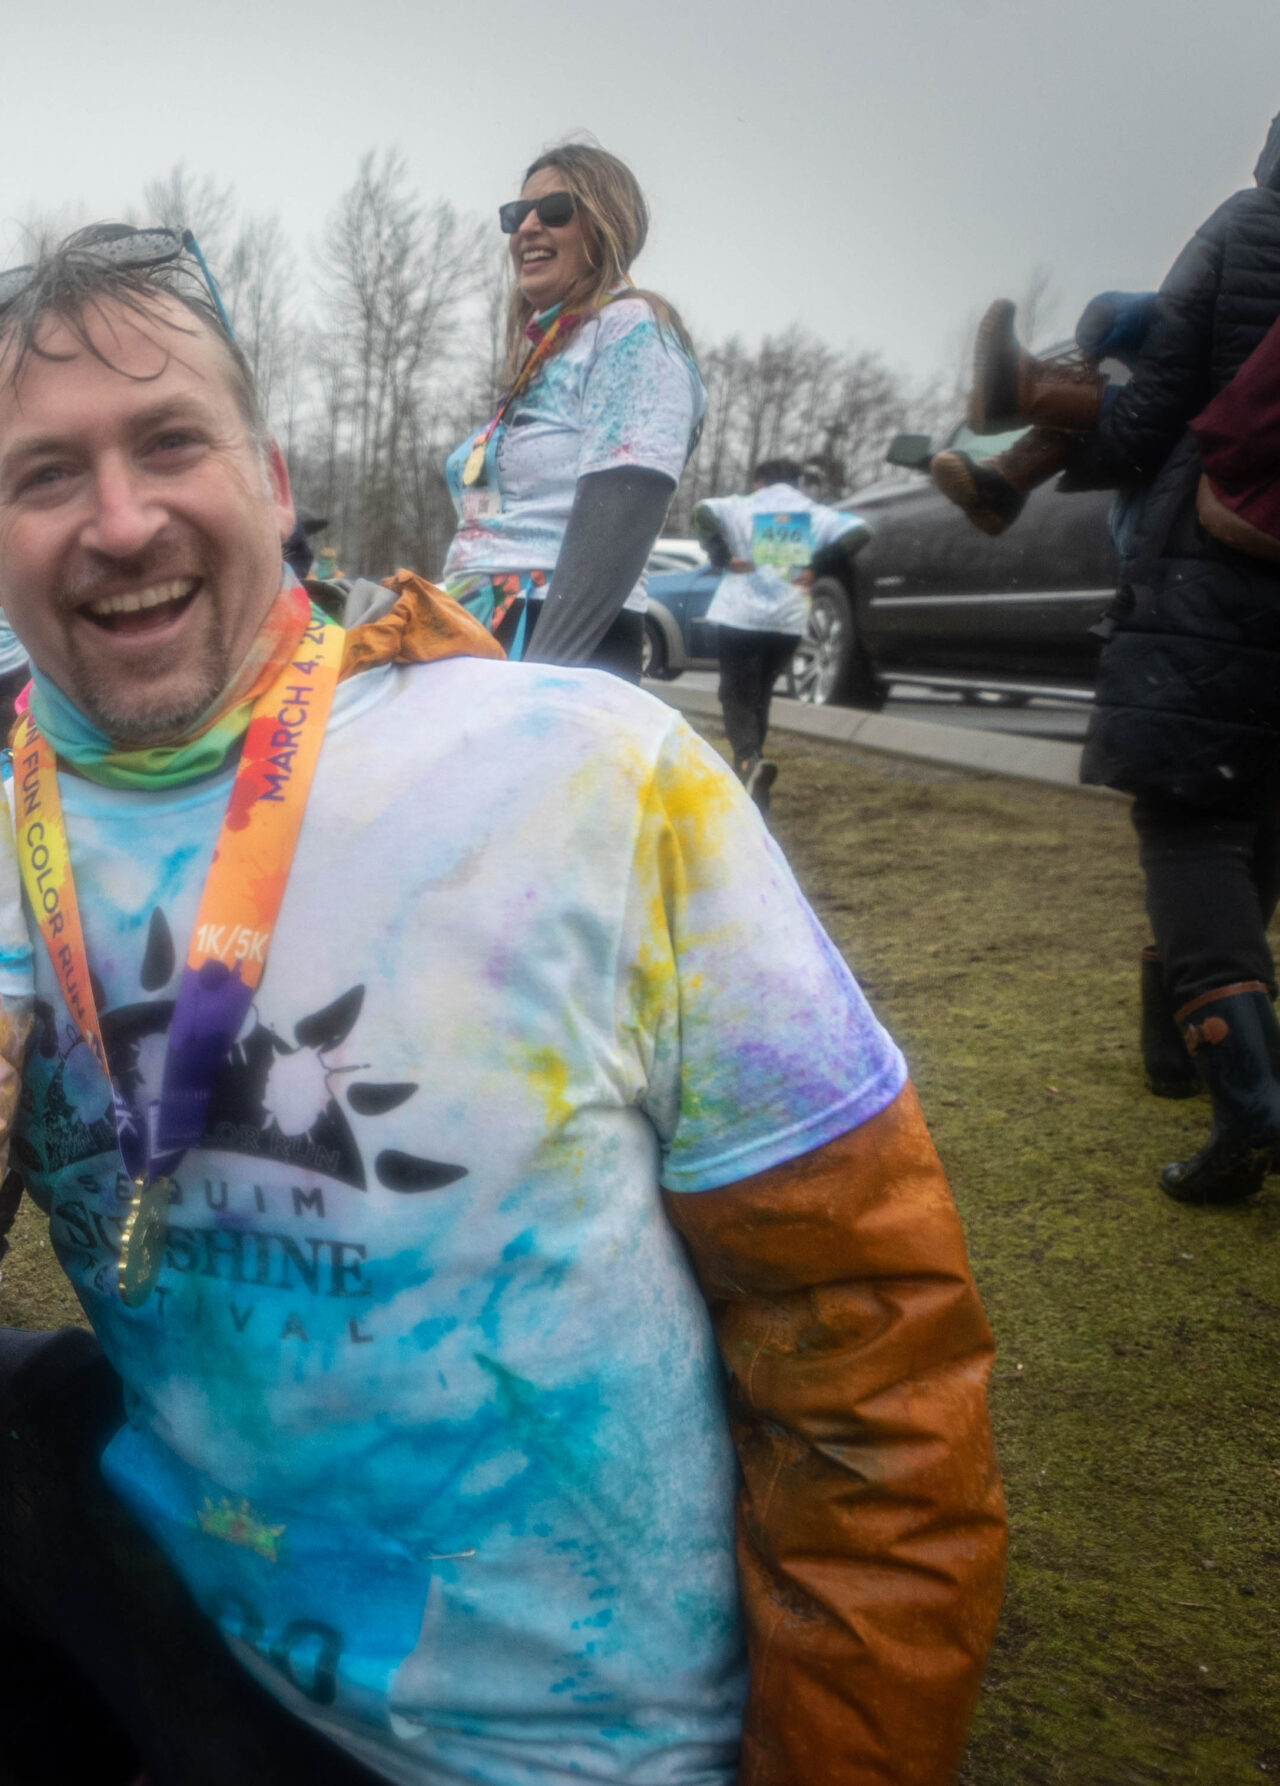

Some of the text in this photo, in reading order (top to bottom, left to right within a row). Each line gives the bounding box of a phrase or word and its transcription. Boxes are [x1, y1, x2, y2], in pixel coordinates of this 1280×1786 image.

[22, 751, 41, 816] FUN
[258, 686, 314, 802] MARCH
[27, 822, 64, 938] COLOR
[58, 944, 85, 1019] RUN
[197, 923, 269, 963] 1K/5K
[55, 1201, 372, 1299] SUSHINE
